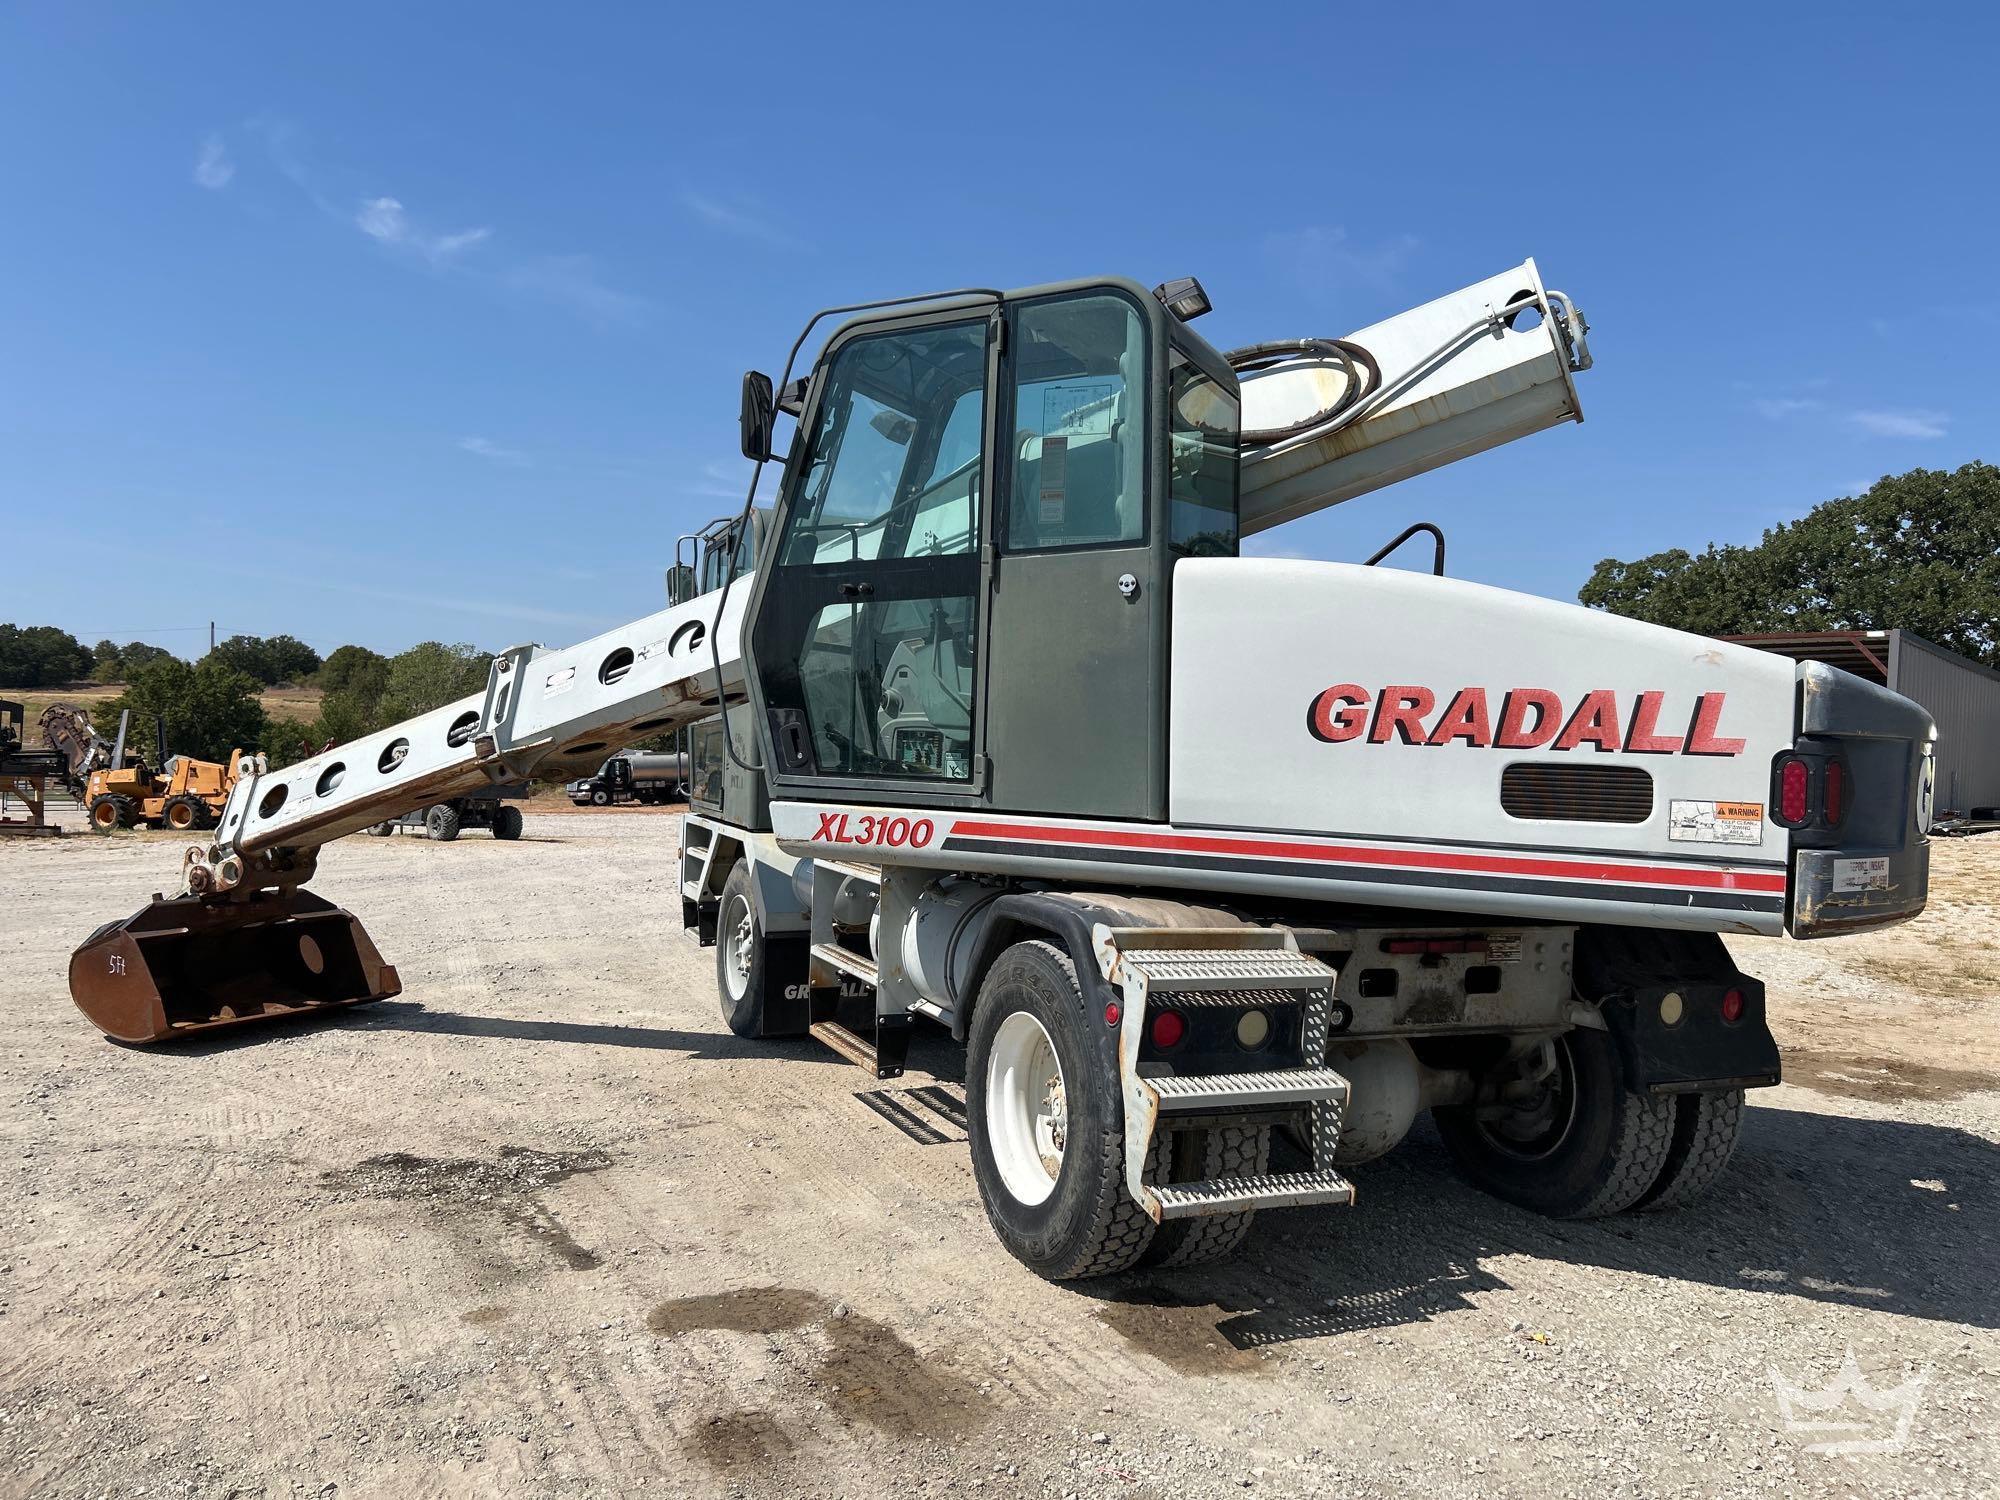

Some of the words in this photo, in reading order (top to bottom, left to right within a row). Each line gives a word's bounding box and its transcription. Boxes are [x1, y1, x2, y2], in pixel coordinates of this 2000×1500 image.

[1306, 684, 1747, 757] GRADALL
[1727, 807, 1759, 817] WARNING
[811, 812, 935, 848] XL3100
[784, 982, 869, 1000] GRALL
